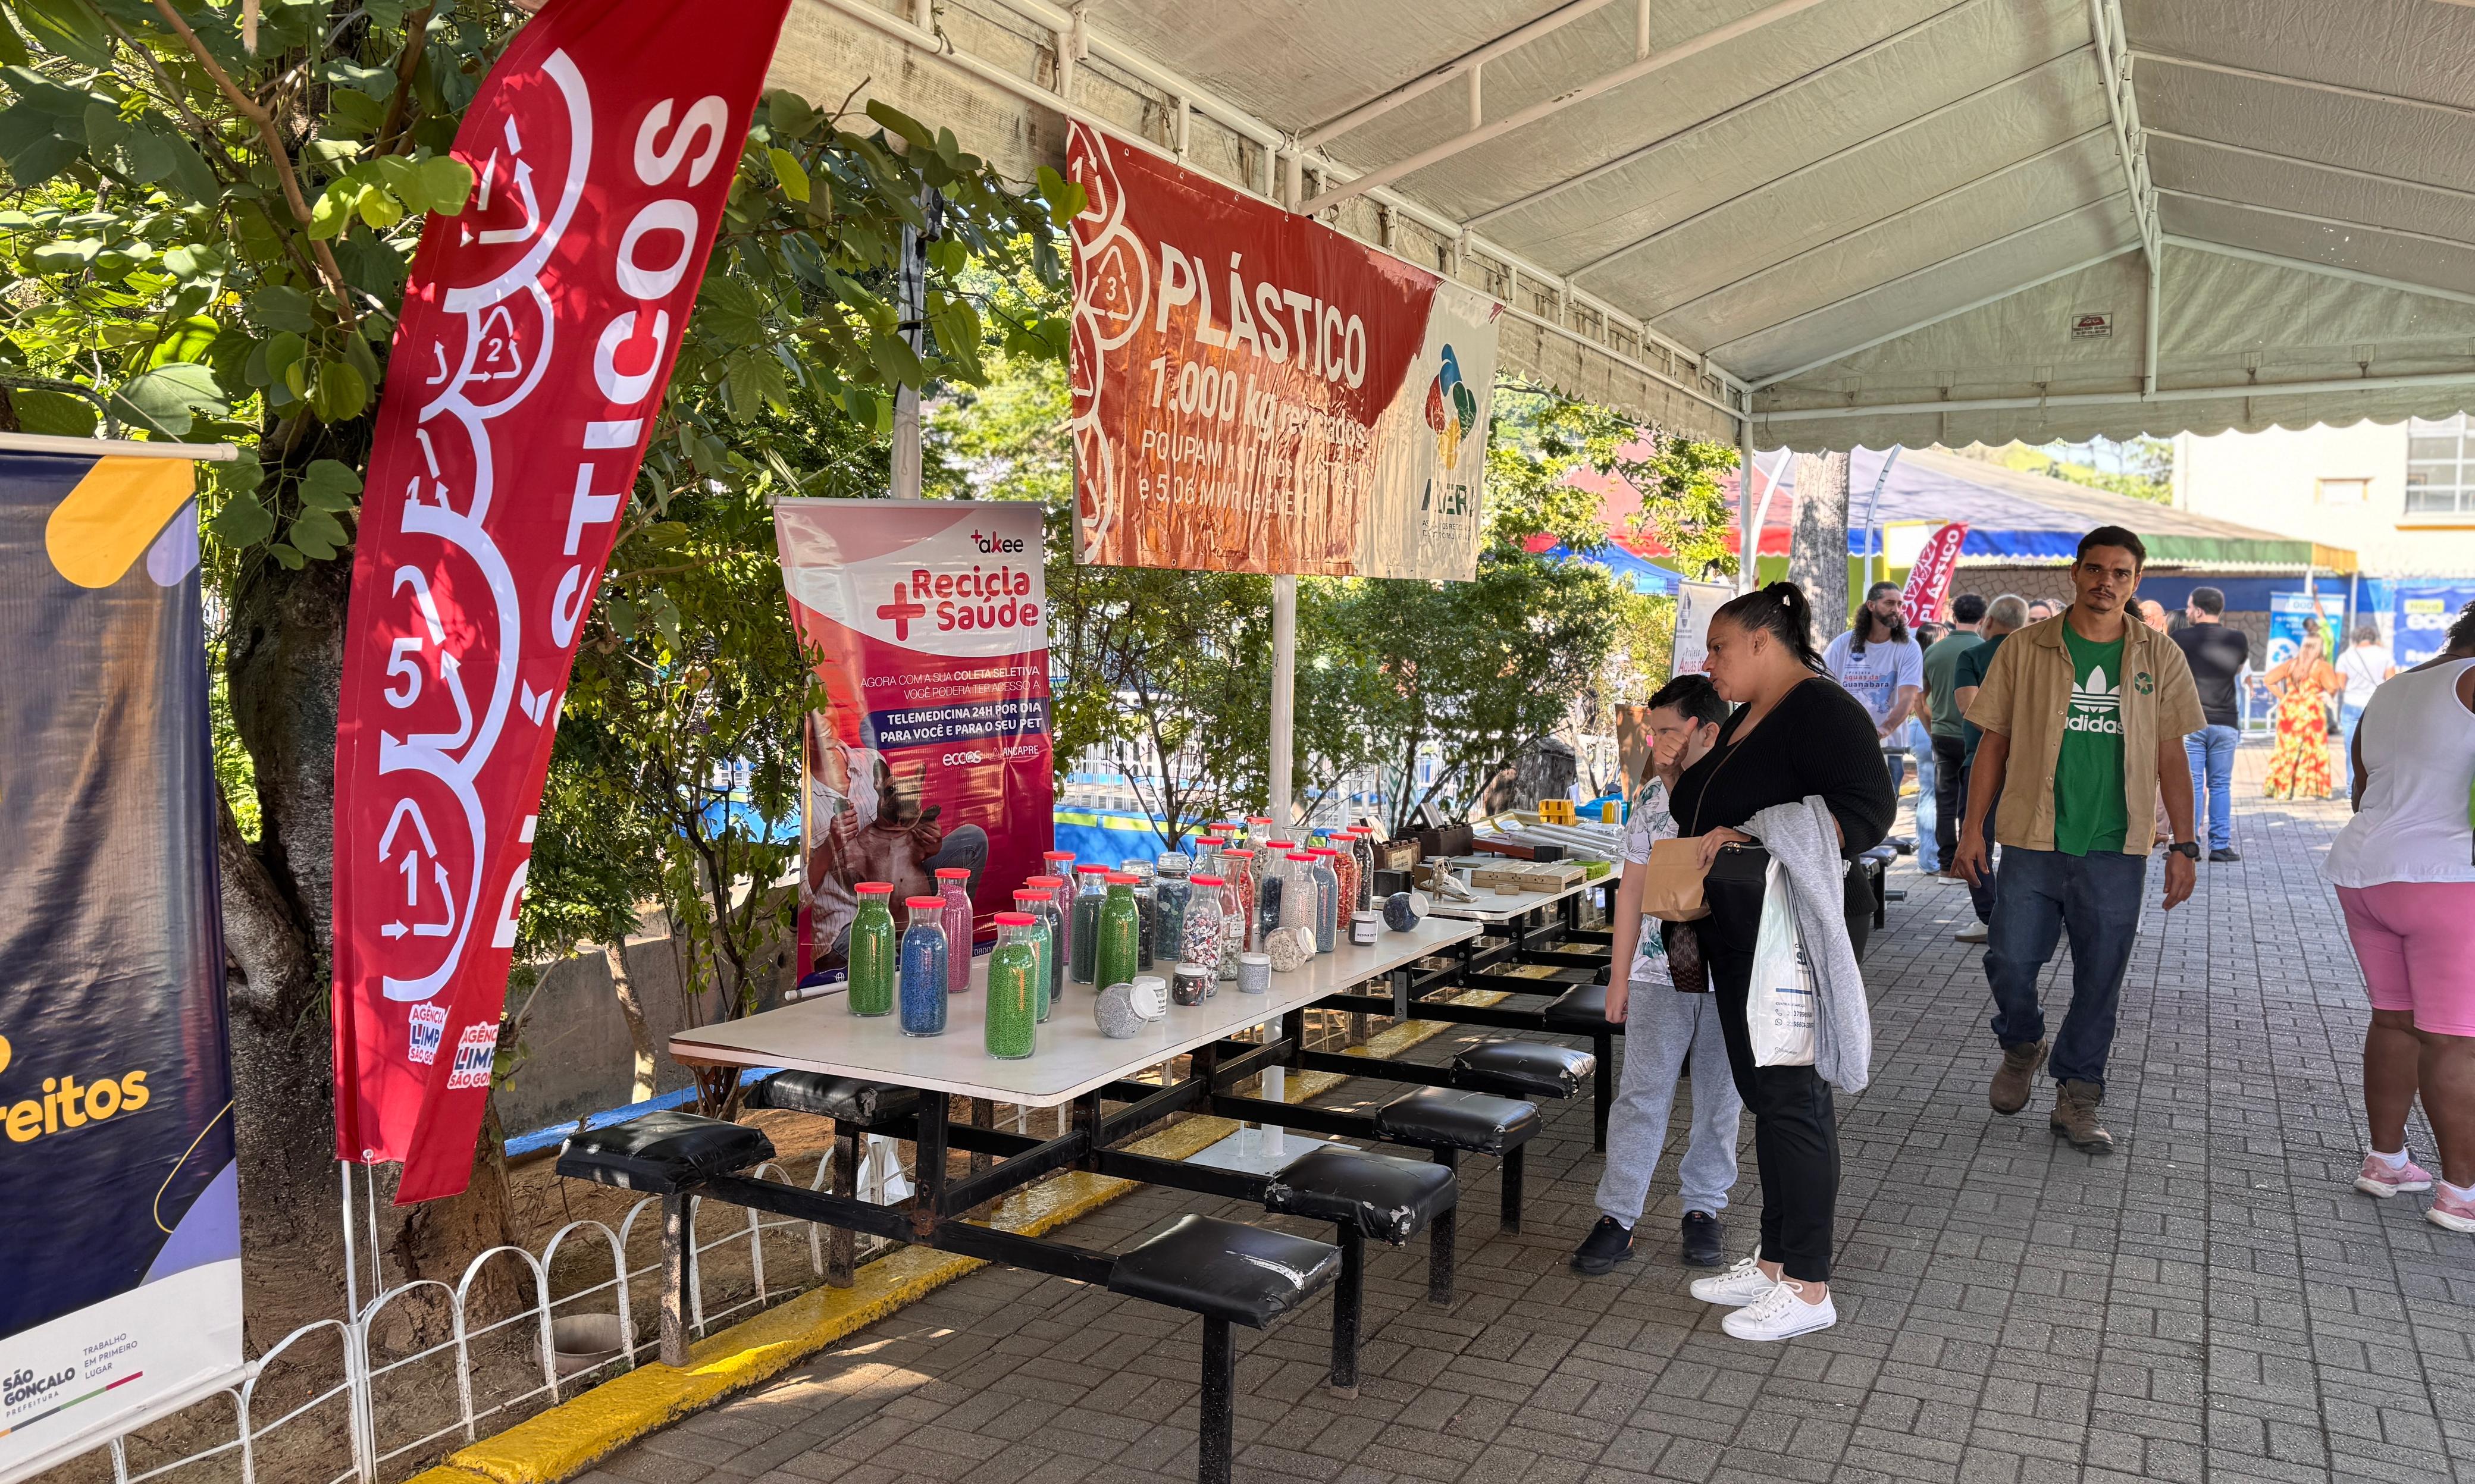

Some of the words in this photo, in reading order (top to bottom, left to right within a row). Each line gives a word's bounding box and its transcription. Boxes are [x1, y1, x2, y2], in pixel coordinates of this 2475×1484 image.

[1072, 156, 1083, 183] 1
[1105, 277, 1117, 302] 3
[1155, 241, 1366, 389] PLÁSTICO
[486, 338, 503, 362] 2
[1150, 356, 1238, 421] 1.000
[1245, 374, 1277, 441] kg
[1279, 404, 1368, 449] recados
[1141, 429, 1223, 468] POUPAM
[1140, 478, 1149, 500] e
[1156, 473, 1195, 507] 5,06
[1199, 479, 1238, 510] MWh
[911, 566, 1030, 599] Recicla
[936, 596, 1039, 631] Saúde
[384, 638, 423, 708] 5
[860, 676, 897, 688] AGORA
[899, 674, 922, 685] COM
[924, 673, 931, 683] A
[933, 672, 952, 682] SUA
[954, 669, 991, 680] COLETA
[993, 666, 1040, 677] SELETIVA
[904, 686, 931, 699] VOCÊ
[933, 683, 971, 697] PODERÁ
[973, 684, 990, 694] TER
[992, 680, 1030, 692] ACESSO
[1033, 680, 1041, 689] A
[887, 708, 970, 725] TELEMEDICINA
[972, 706, 992, 717] 24H
[995, 704, 1017, 714] POR
[1020, 702, 1042, 713] DIA
[881, 730, 911, 742] PARA
[913, 724, 944, 739] VOCÊ
[946, 726, 953, 736] E
[955, 723, 982, 735] PARA
[985, 721, 993, 732] O
[995, 719, 1016, 730] SEU
[1020, 718, 1042, 729] PET
[1003, 745, 1039, 756] ANCAPRE
[400, 850, 418, 906] 1
[974, 946, 991, 956] 0800
[410, 1046, 423, 1059] SÃO
[449, 1071, 471, 1087] SÃO
[83, 1333, 127, 1356] TRABALHO
[84, 1357, 96, 1368] EM
[99, 1340, 138, 1362] PRIMEIRO
[3, 1369, 33, 1392] SÃO
[85, 1362, 112, 1379] LUGAR
[4, 1367, 76, 1406] GONÇALO
[6, 1391, 59, 1418] PREFEITURA
